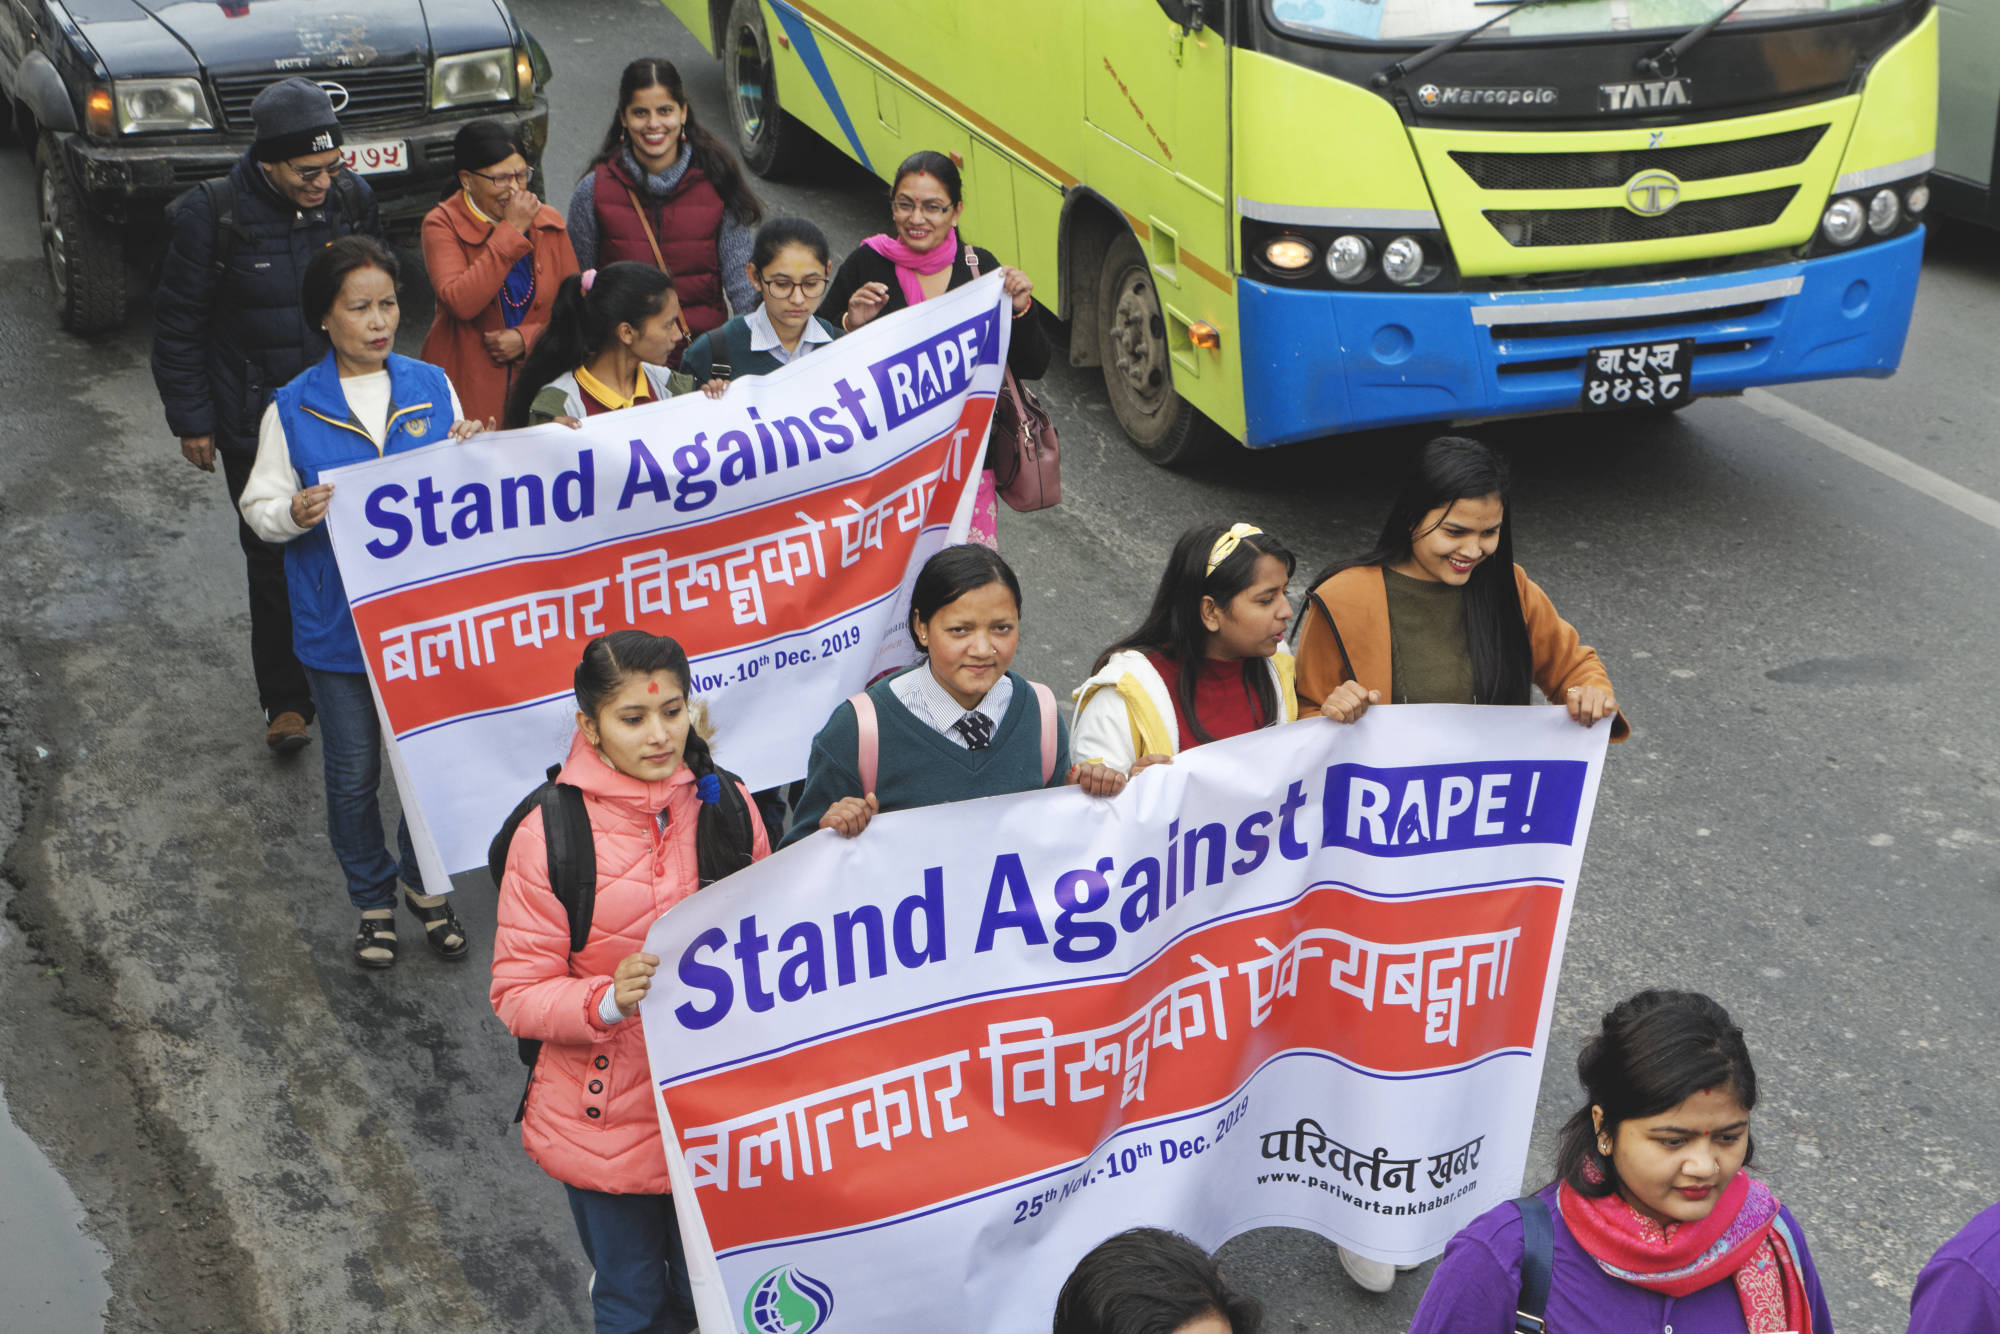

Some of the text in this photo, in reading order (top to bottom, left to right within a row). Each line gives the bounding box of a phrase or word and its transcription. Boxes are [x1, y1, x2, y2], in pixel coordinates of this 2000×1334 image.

[1442, 87, 1556, 105] Marcopolo
[1604, 80, 1687, 110] TATA
[1588, 373, 1682, 405] ४४३८
[364, 449, 595, 560] Stand
[617, 378, 878, 512] Against
[380, 577, 610, 682] बलात्कार
[775, 649, 816, 669] Dec.
[821, 625, 860, 658] 2019
[674, 866, 946, 1030] Stand
[975, 779, 1309, 964] Against
[683, 1049, 970, 1191] बलात्कार
[1260, 1118, 1485, 1193] परिवर्तन खबर
[1013, 1188, 1057, 1224] 25th
[1160, 1135, 1211, 1165] Dec.
[1215, 1095, 1249, 1143] 2019
[1257, 1171, 1477, 1215] www.pariwartankhabar.com
